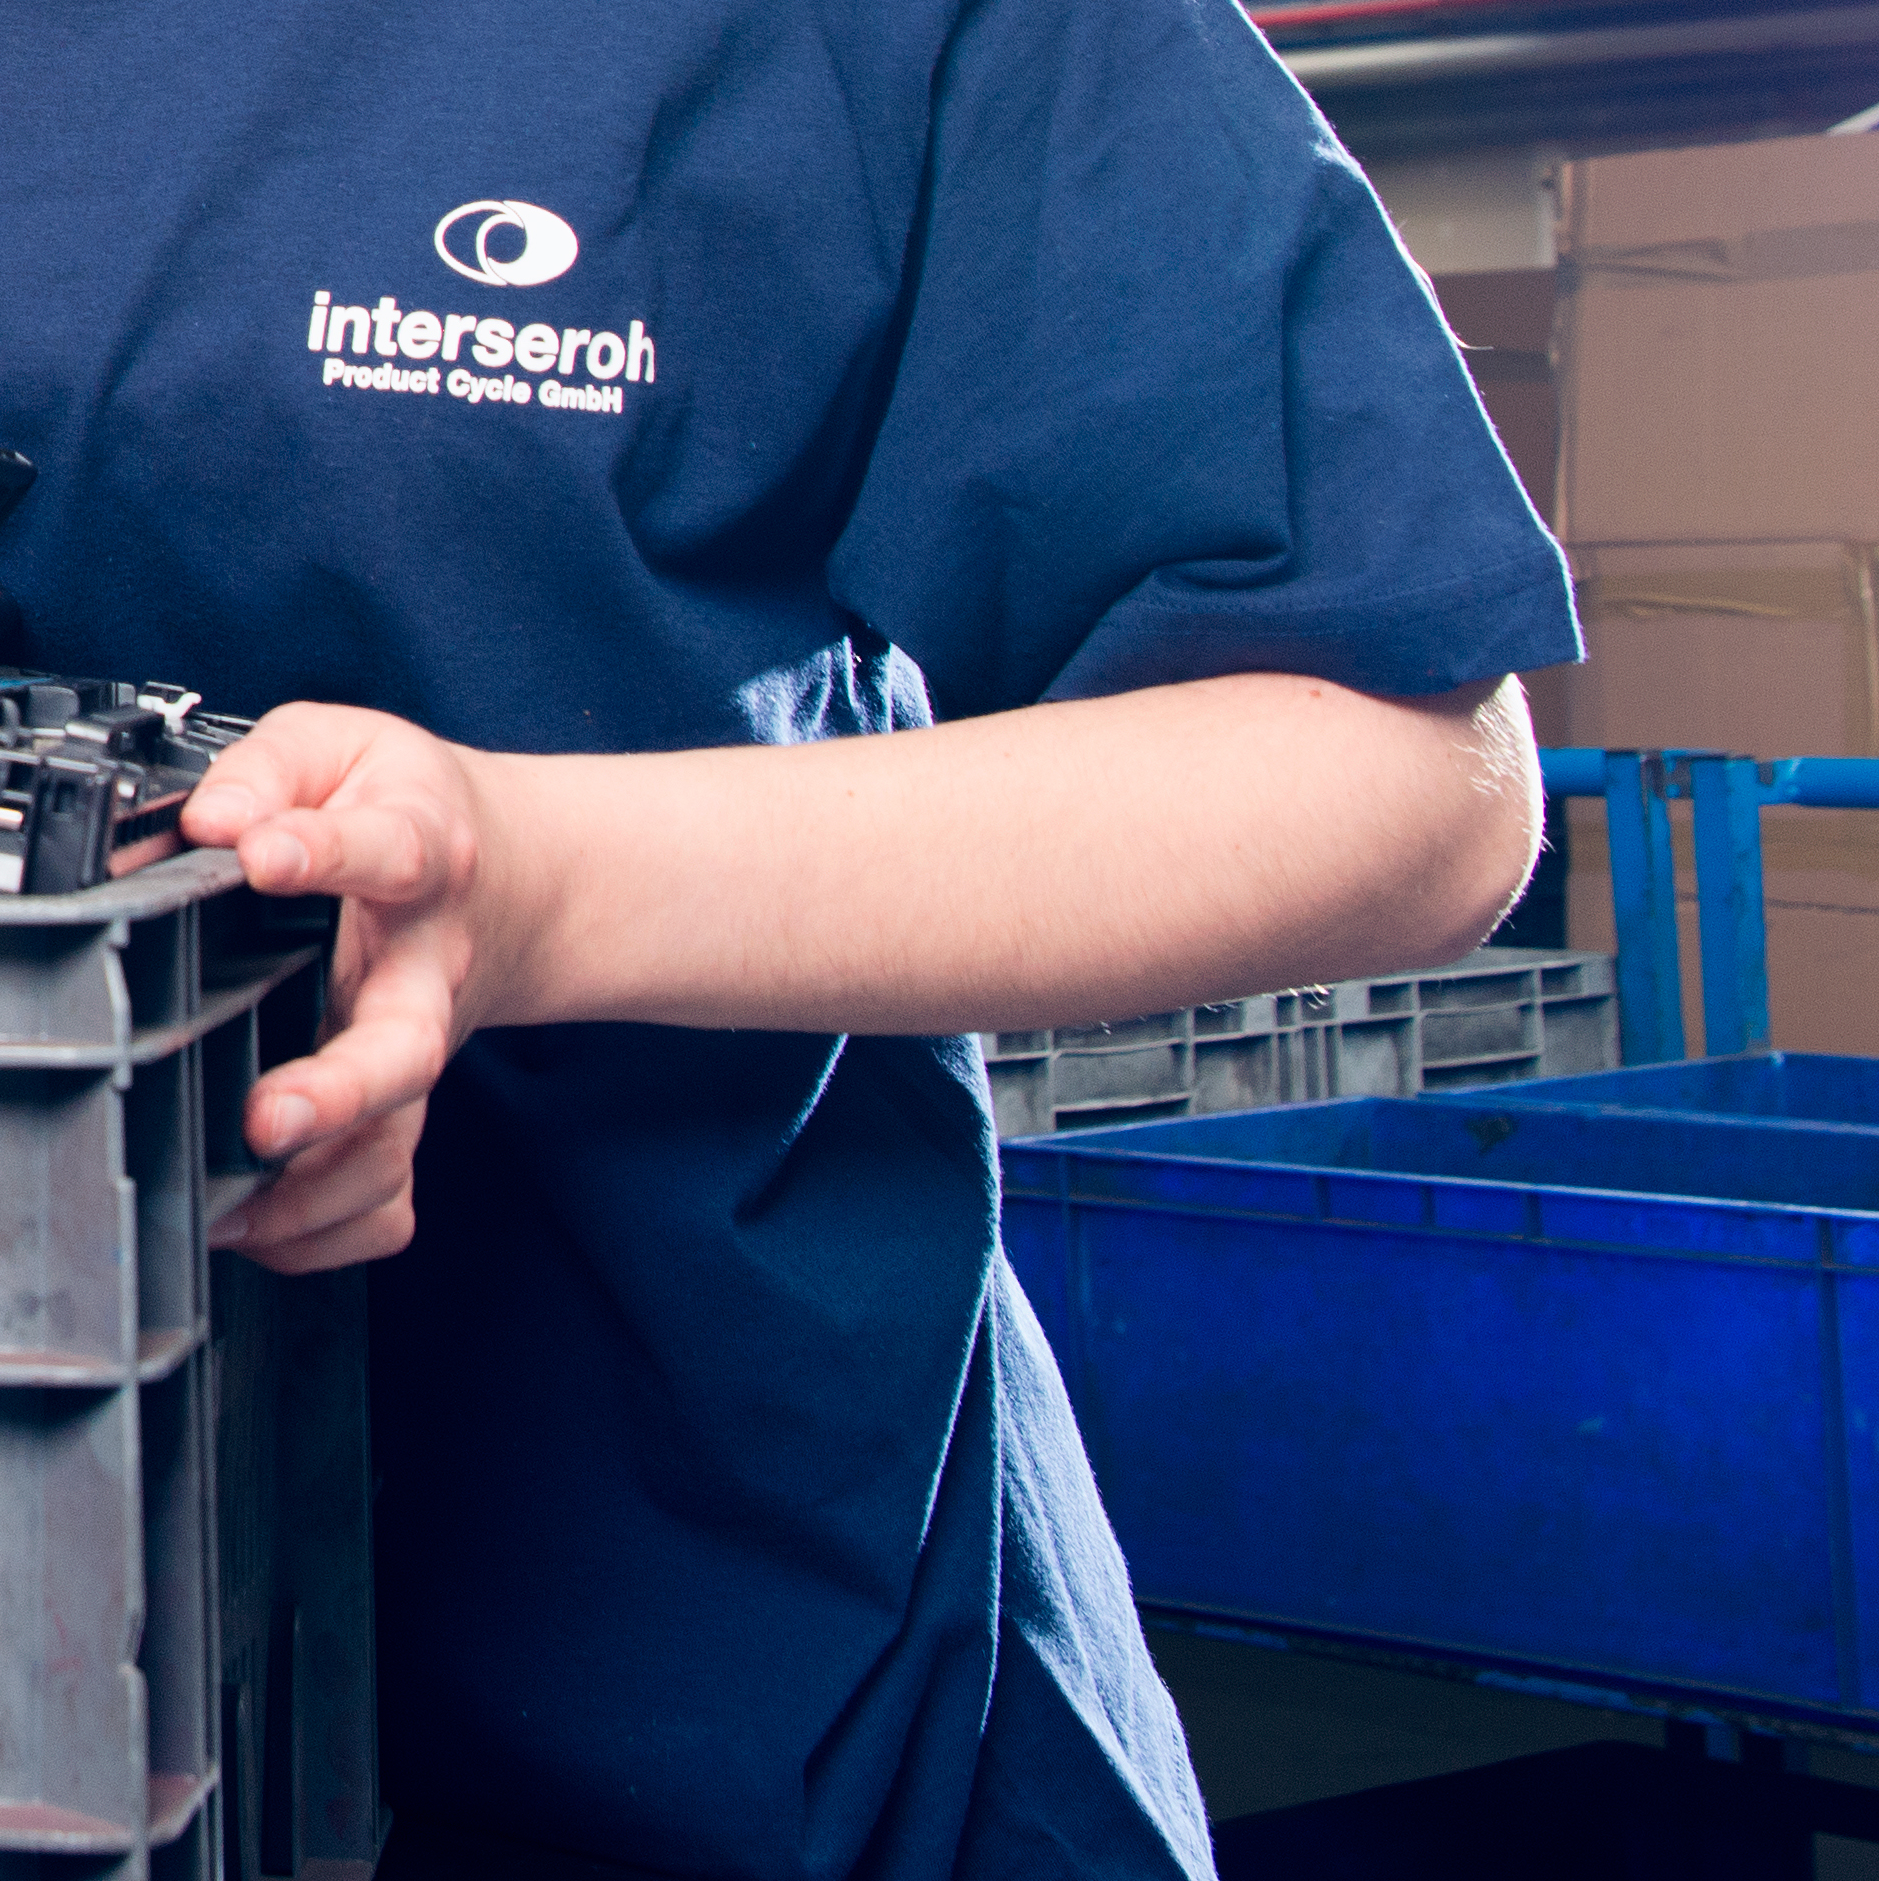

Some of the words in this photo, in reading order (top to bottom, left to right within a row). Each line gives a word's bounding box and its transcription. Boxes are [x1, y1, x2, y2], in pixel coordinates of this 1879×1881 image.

[307, 290, 656, 384] interseroh
[323, 358, 442, 396] Product
[446, 368, 533, 404] Cycle
[538, 379, 624, 414] GmbH
